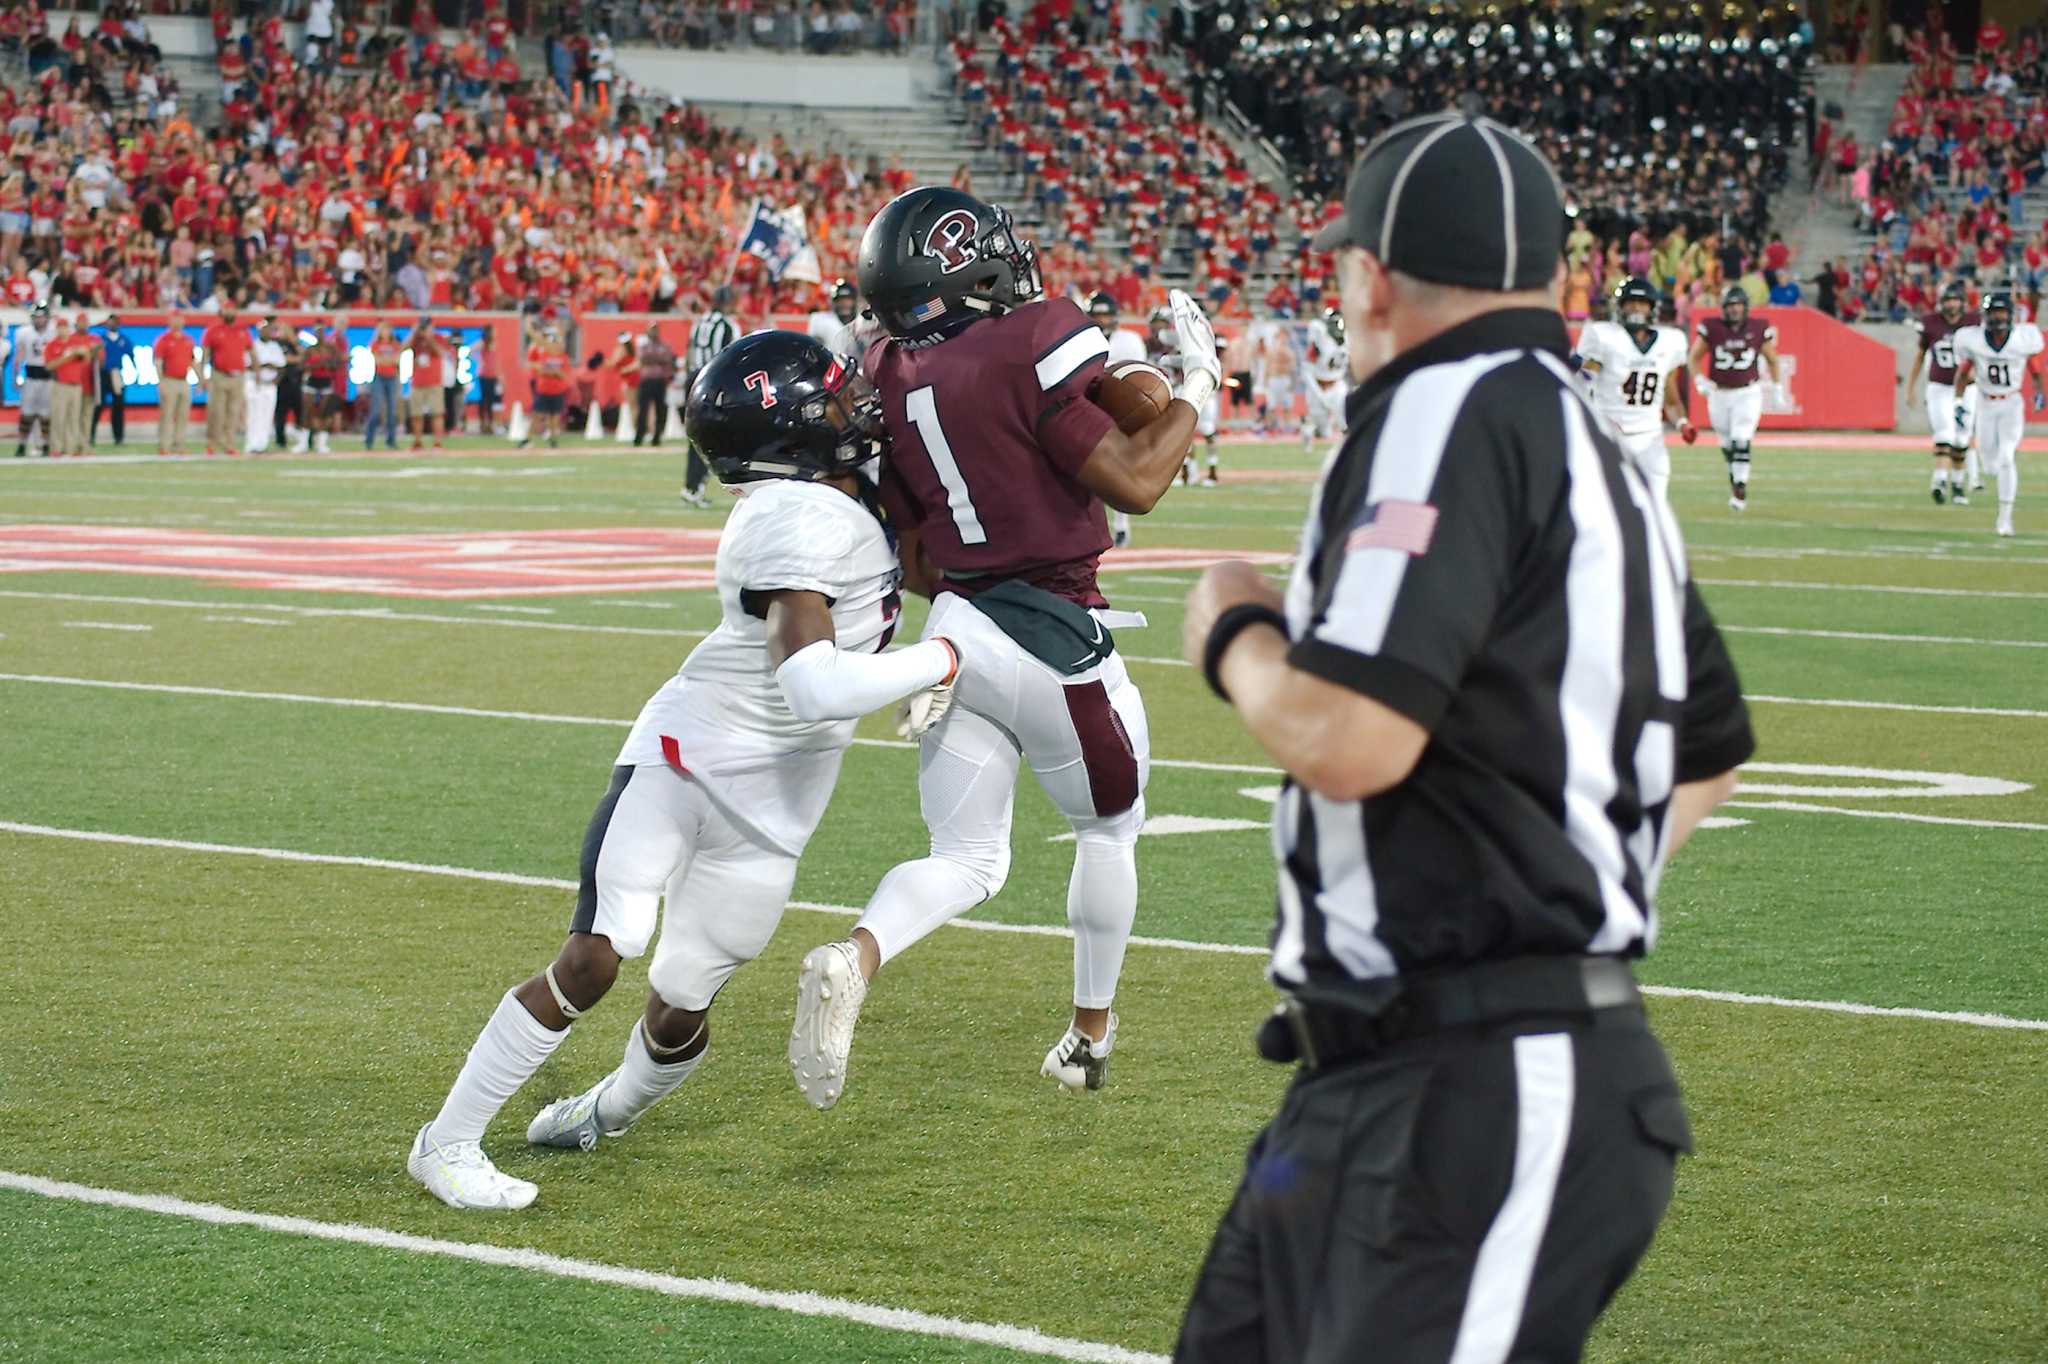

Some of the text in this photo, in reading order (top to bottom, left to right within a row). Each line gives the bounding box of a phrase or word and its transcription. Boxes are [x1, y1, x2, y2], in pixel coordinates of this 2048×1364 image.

[923, 208, 979, 275] P
[1714, 345, 1756, 370] 53
[743, 370, 778, 410] 7
[1623, 371, 1658, 406] 48
[905, 384, 988, 545] 1
